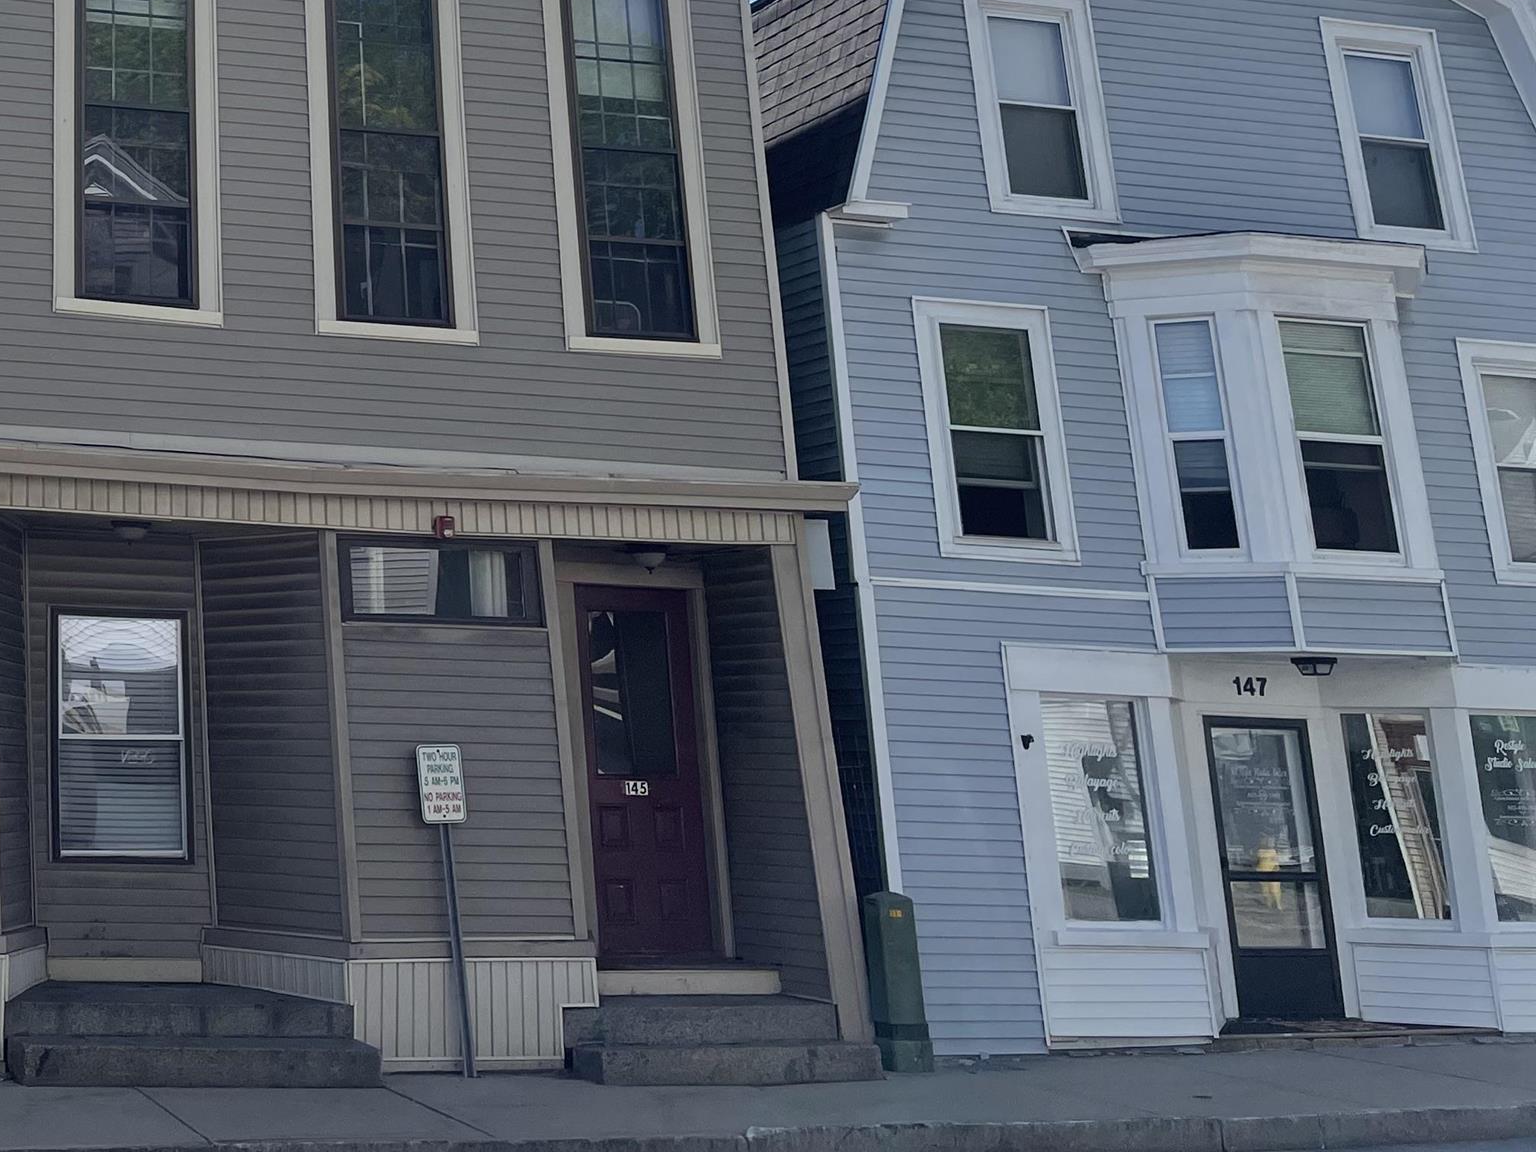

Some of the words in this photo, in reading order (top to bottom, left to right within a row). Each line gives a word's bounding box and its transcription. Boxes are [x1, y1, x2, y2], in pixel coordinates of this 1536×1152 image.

[1232, 675, 1268, 697] 147
[1494, 739, 1525, 756] Restyle
[422, 752, 437, 762] TWO
[439, 752, 457, 762] HOUR
[1361, 748, 1414, 761] Hlights
[426, 764, 454, 774] PARKING
[1484, 756, 1513, 771] Studio
[1515, 757, 1536, 772] Salo
[625, 781, 648, 796] 145
[424, 792, 434, 802] NO
[436, 792, 463, 802] PARKING
[452, 805, 462, 814] AM
